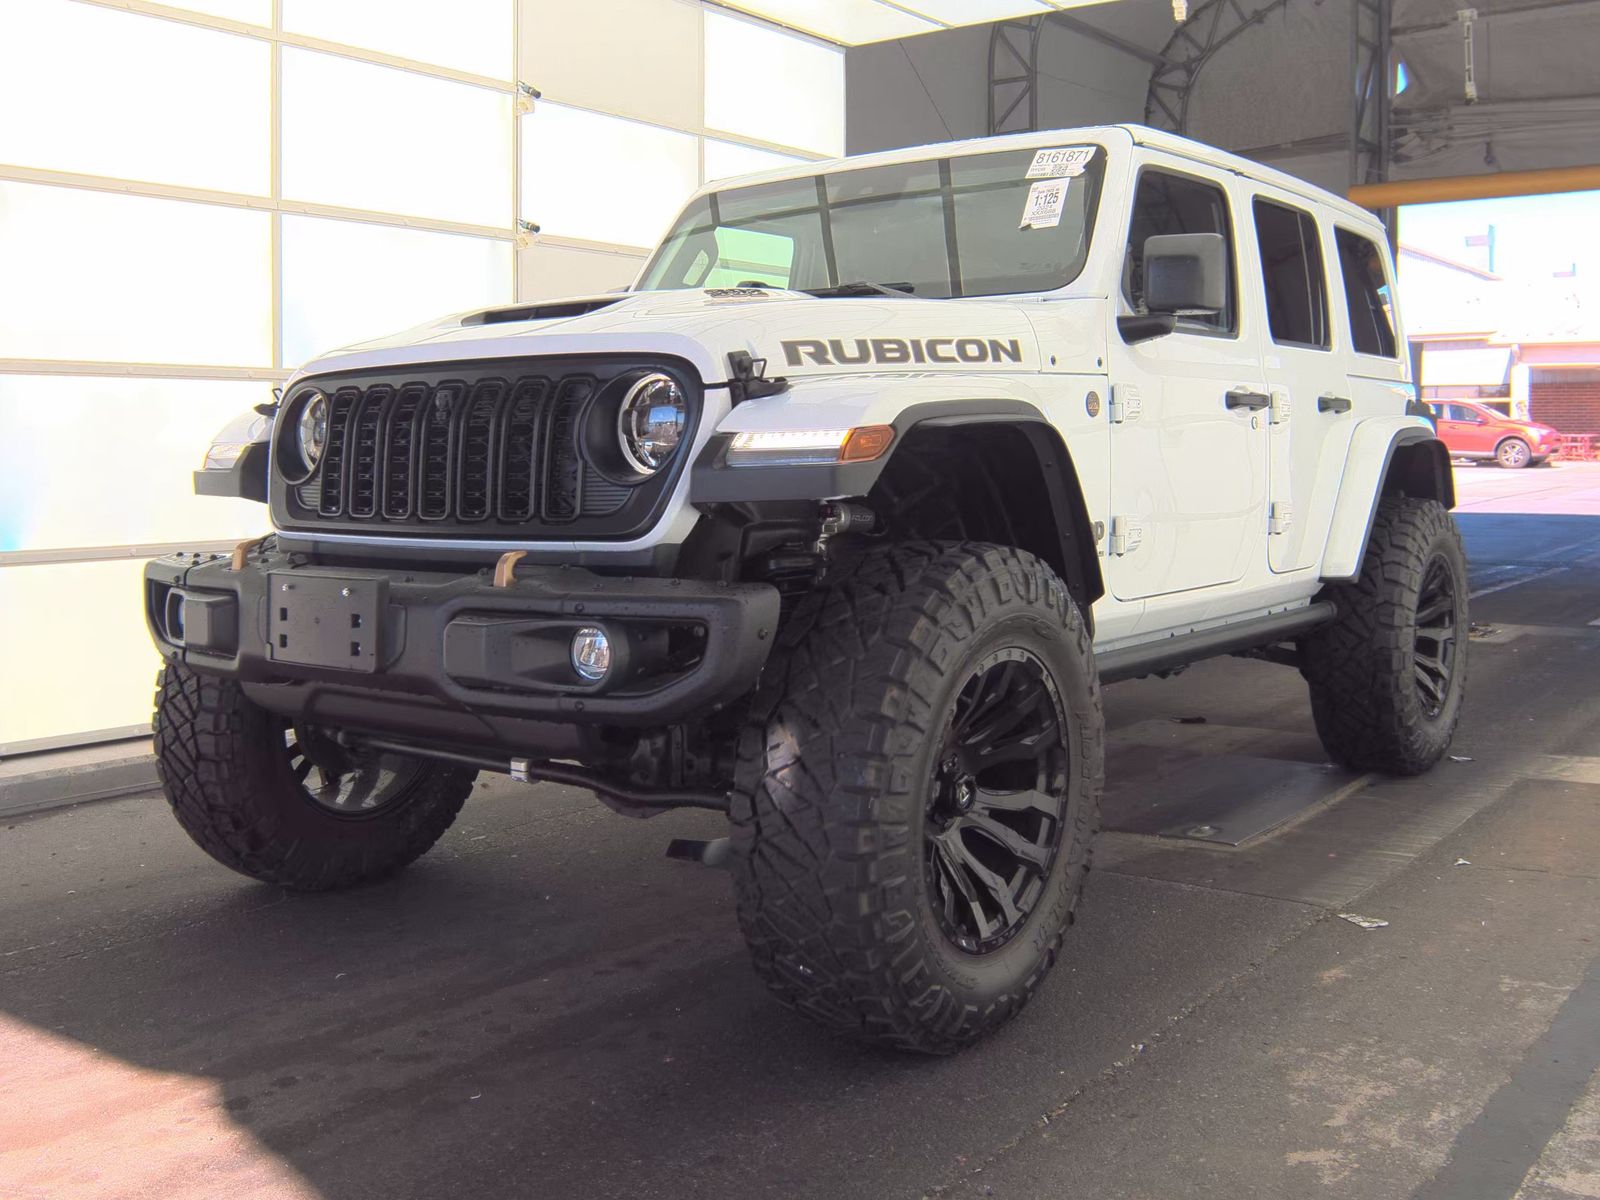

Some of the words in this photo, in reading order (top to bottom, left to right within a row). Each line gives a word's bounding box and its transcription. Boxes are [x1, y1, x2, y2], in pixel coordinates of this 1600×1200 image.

[1036, 150, 1089, 163] 8161871
[1034, 192, 1059, 206] 1:125
[780, 338, 1023, 367] RUBICON
